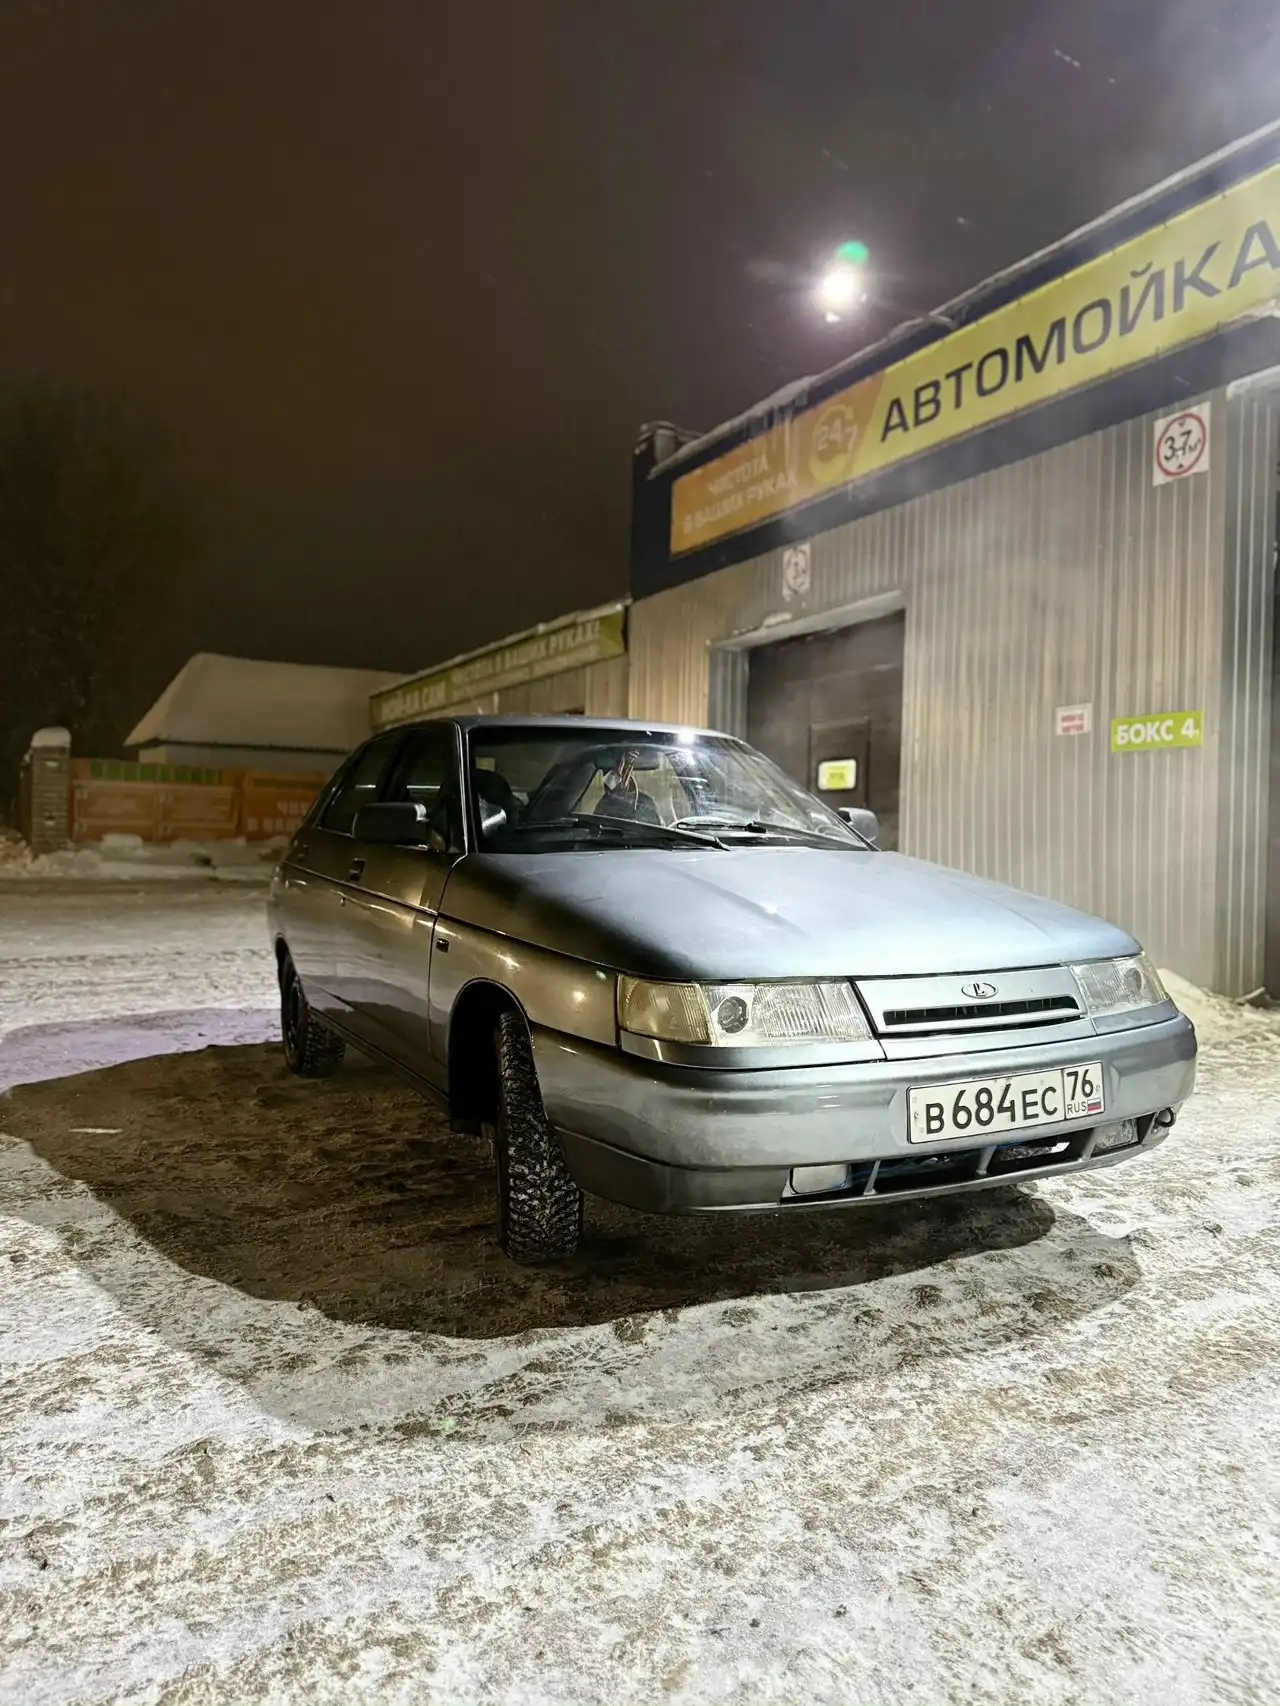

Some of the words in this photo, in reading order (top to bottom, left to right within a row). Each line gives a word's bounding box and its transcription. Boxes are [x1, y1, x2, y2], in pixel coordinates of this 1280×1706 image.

[880, 219, 1280, 442] АВТОМОЙКА
[1117, 719, 1174, 745] БОКС
[1066, 1069, 1094, 1101] 76
[1066, 1098, 1087, 1114] RUS
